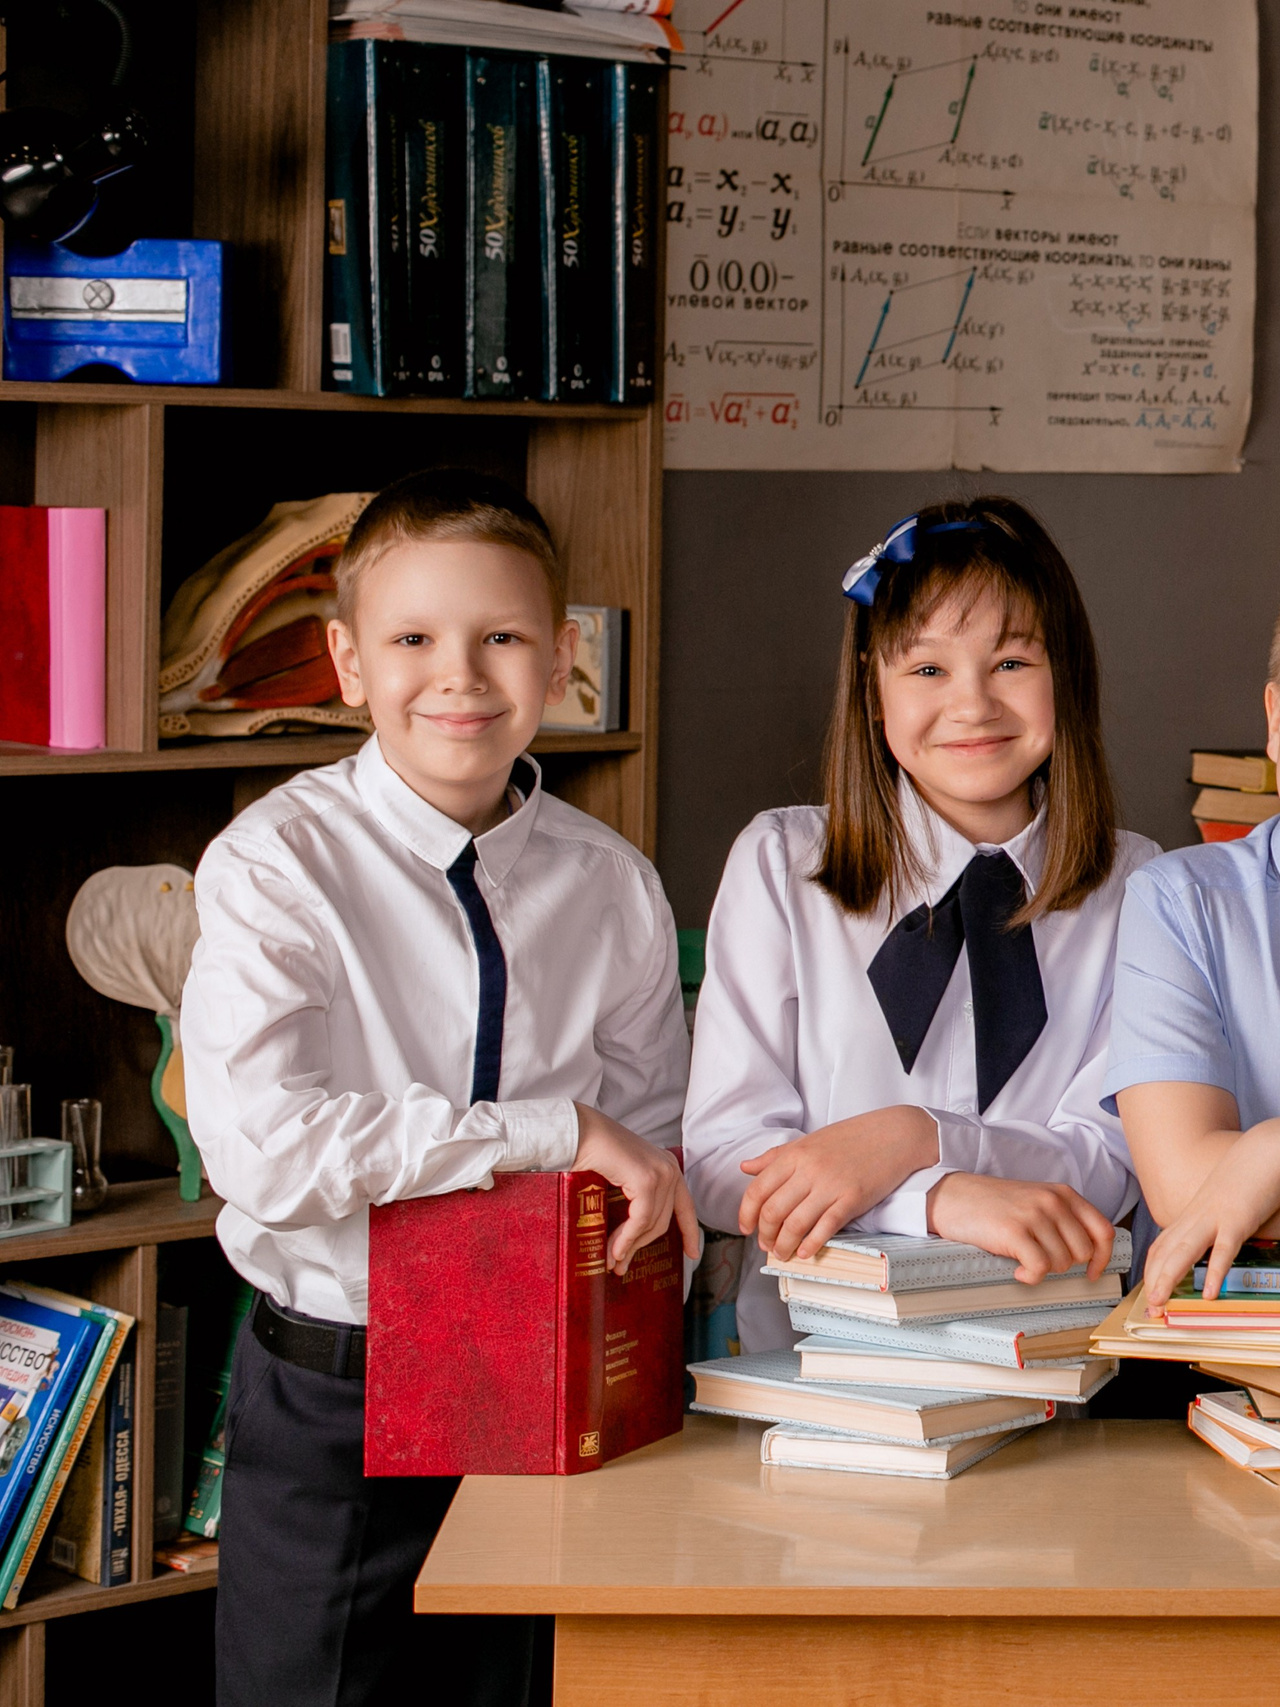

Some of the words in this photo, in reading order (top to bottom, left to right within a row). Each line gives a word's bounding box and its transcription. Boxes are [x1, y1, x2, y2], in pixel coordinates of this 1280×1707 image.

[926, 10, 983, 30] равные
[988, 17, 1125, 44] соответствующие
[1129, 33, 1215, 52] координаты
[1068, 8, 1122, 24] имеют
[419, 228, 439, 260] 50
[485, 230, 507, 264] 50
[995, 226, 1061, 244] векторы
[1067, 232, 1120, 247] имеют
[563, 239, 579, 268] 50
[833, 239, 893, 256] равные
[899, 242, 1040, 263] соответствующие
[1158, 256, 1185, 269] они
[1188, 258, 1231, 271] равны
[743, 296, 809, 312] вектор
[635, 1257, 673, 1283] глубины
[0, 1340, 46, 1371] ССТВО
[25, 1407, 62, 1475] ИСКУССТВО
[61, 1395, 99, 1474] ГЕОГРАФИЯ
[115, 1429, 131, 1483] ОДЕССА
[17, 1479, 64, 1578] ЭНЦИКЛОПЕДИЯ
